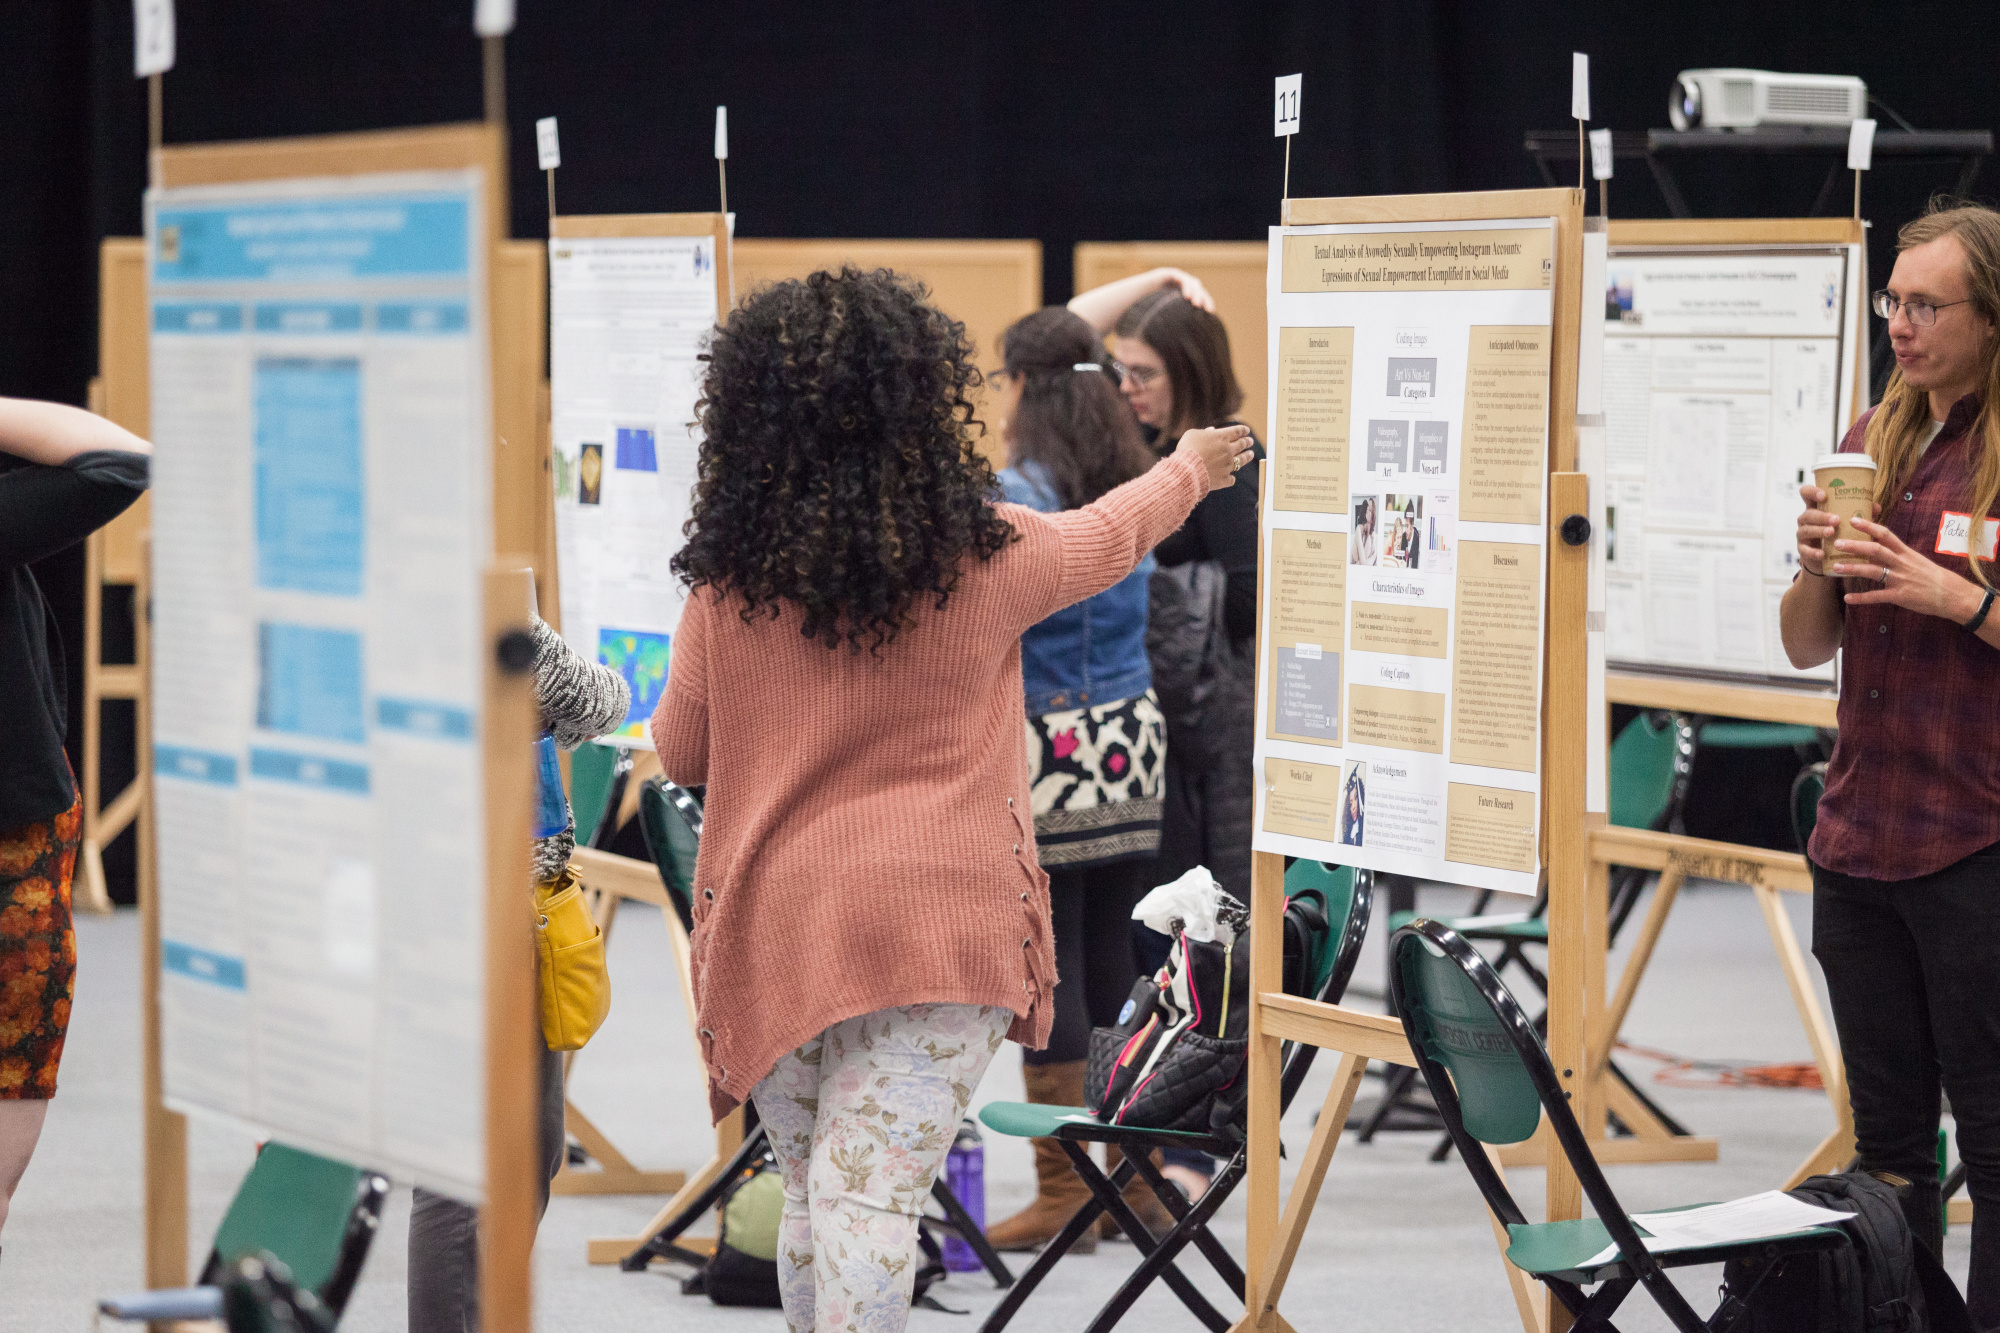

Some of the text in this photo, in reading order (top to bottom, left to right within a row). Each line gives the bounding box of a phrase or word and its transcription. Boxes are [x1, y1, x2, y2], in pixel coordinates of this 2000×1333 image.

[1279, 90, 1297, 123] 11
[1314, 242, 1522, 262] Textual Analysis of Avowedly Sexually Empowering Instagram Accounts:
[1354, 267, 1361, 282] of
[1361, 267, 1381, 282] Sexual
[1382, 266, 1427, 285] Empowerment
[1428, 265, 1463, 285] Exemplified
[1464, 265, 1471, 280] in
[1472, 265, 1490, 281] Social
[1490, 265, 1509, 280] Media
[1396, 332, 1428, 348] Coding Images
[1488, 339, 1539, 352] Anticipated Outcomes
[1394, 368, 1403, 381] Art
[1383, 466, 1392, 477] Art
[1493, 554, 1519, 566] Discussion
[1372, 580, 1405, 595] Characteristics
[1410, 583, 1424, 598] Images
[1393, 668, 1410, 681] Captions
[1302, 771, 1313, 782] Cited
[1478, 795, 1514, 810] Future Research
